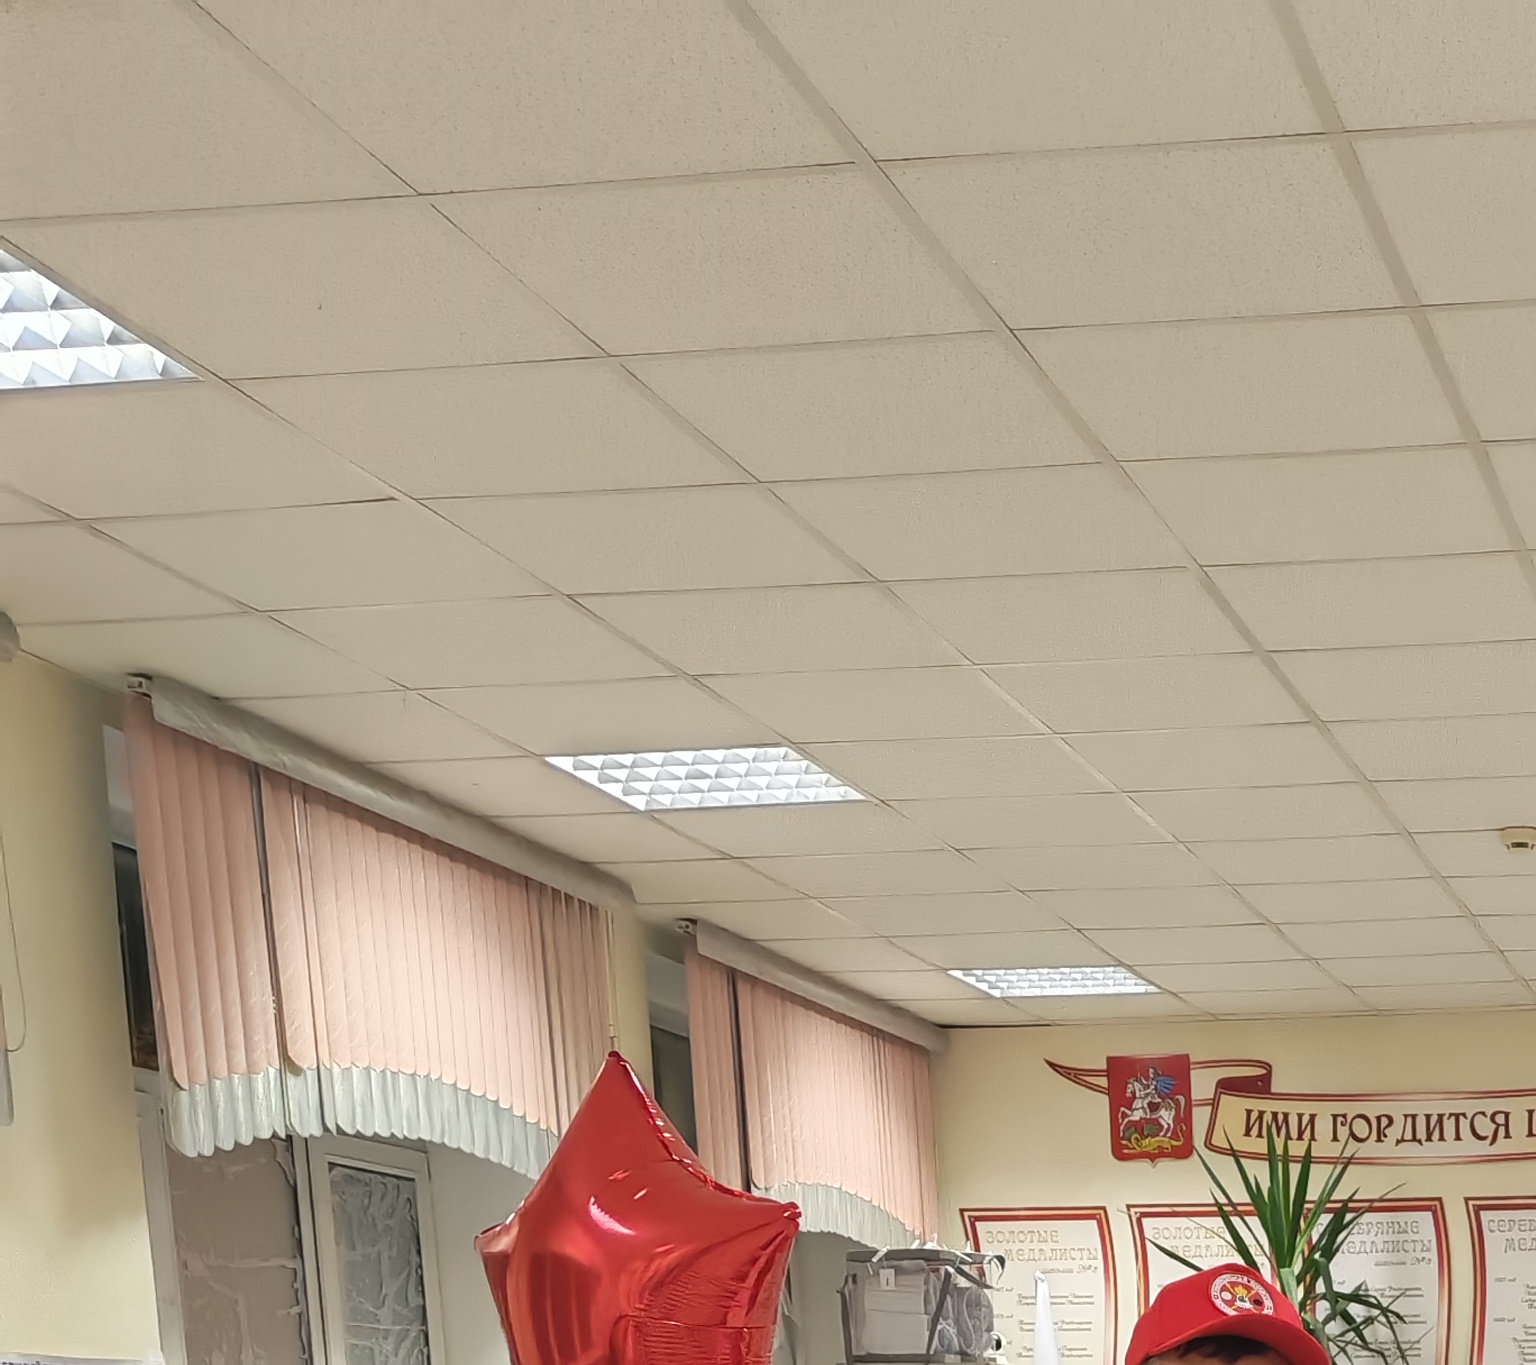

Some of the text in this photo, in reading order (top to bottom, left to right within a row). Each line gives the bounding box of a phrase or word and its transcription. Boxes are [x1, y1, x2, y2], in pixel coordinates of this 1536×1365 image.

[1242, 1108, 1319, 1142] ИМИ
[1330, 1110, 1514, 1147] ГОРДИТСЯ
[985, 1229, 1060, 1244] ЗОЛОТЫЕ
[1004, 1247, 1099, 1263] МЕДАЛИСТЫ
